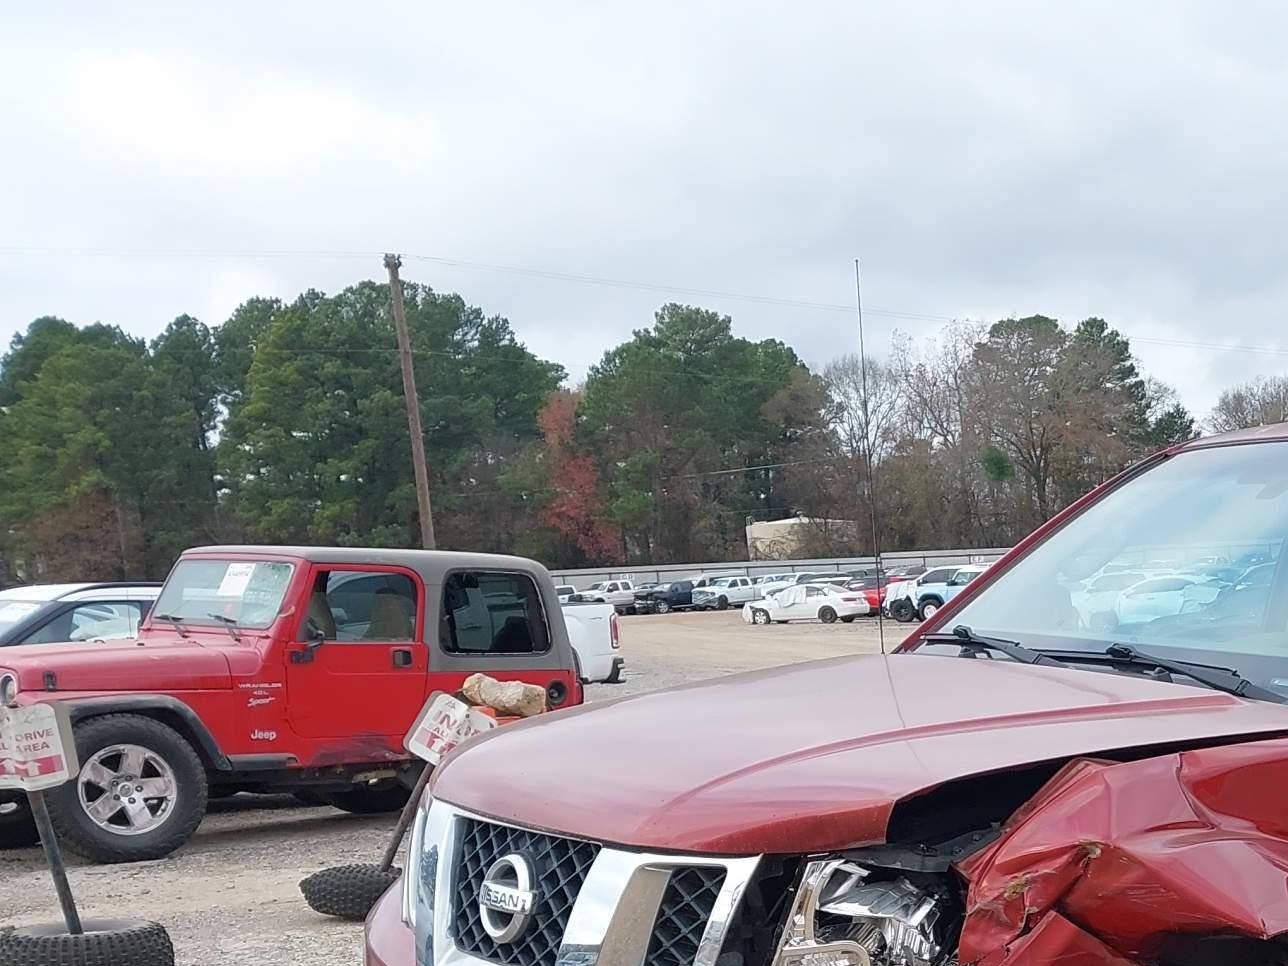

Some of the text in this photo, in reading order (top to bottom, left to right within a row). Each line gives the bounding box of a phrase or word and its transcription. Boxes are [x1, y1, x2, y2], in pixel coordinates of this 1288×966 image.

[15, 728, 55, 742] DRIVE
[251, 729, 277, 741] Jeep
[16, 742, 50, 753] AREA
